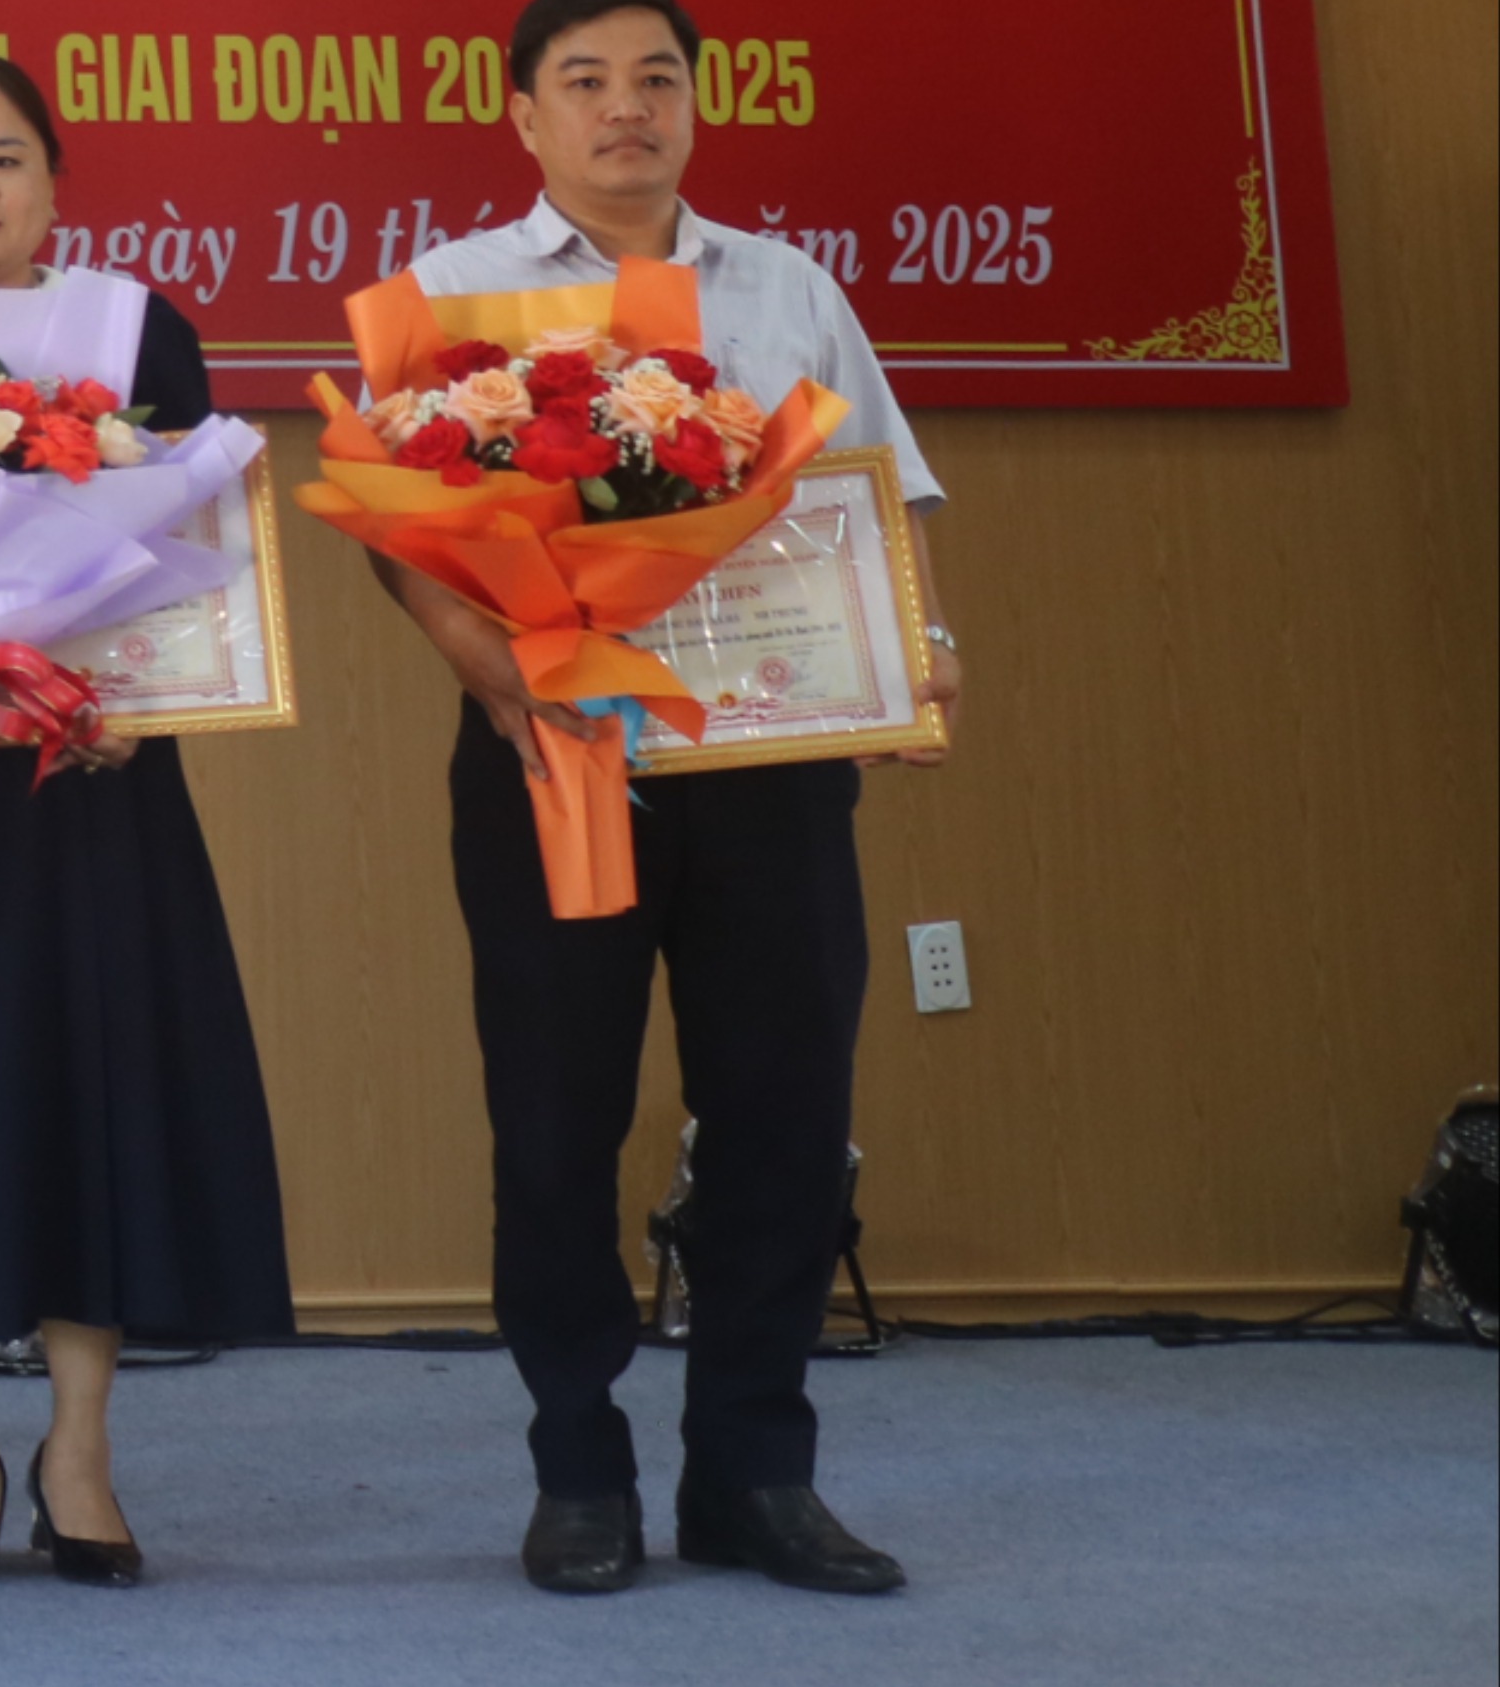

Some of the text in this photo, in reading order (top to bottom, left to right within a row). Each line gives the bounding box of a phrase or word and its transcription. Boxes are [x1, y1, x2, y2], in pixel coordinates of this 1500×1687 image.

[57, 34, 191, 122] GIAI
[214, 35, 400, 142] ĐOẠN
[269, 202, 348, 283] 19
[889, 205, 1052, 285] 2025
